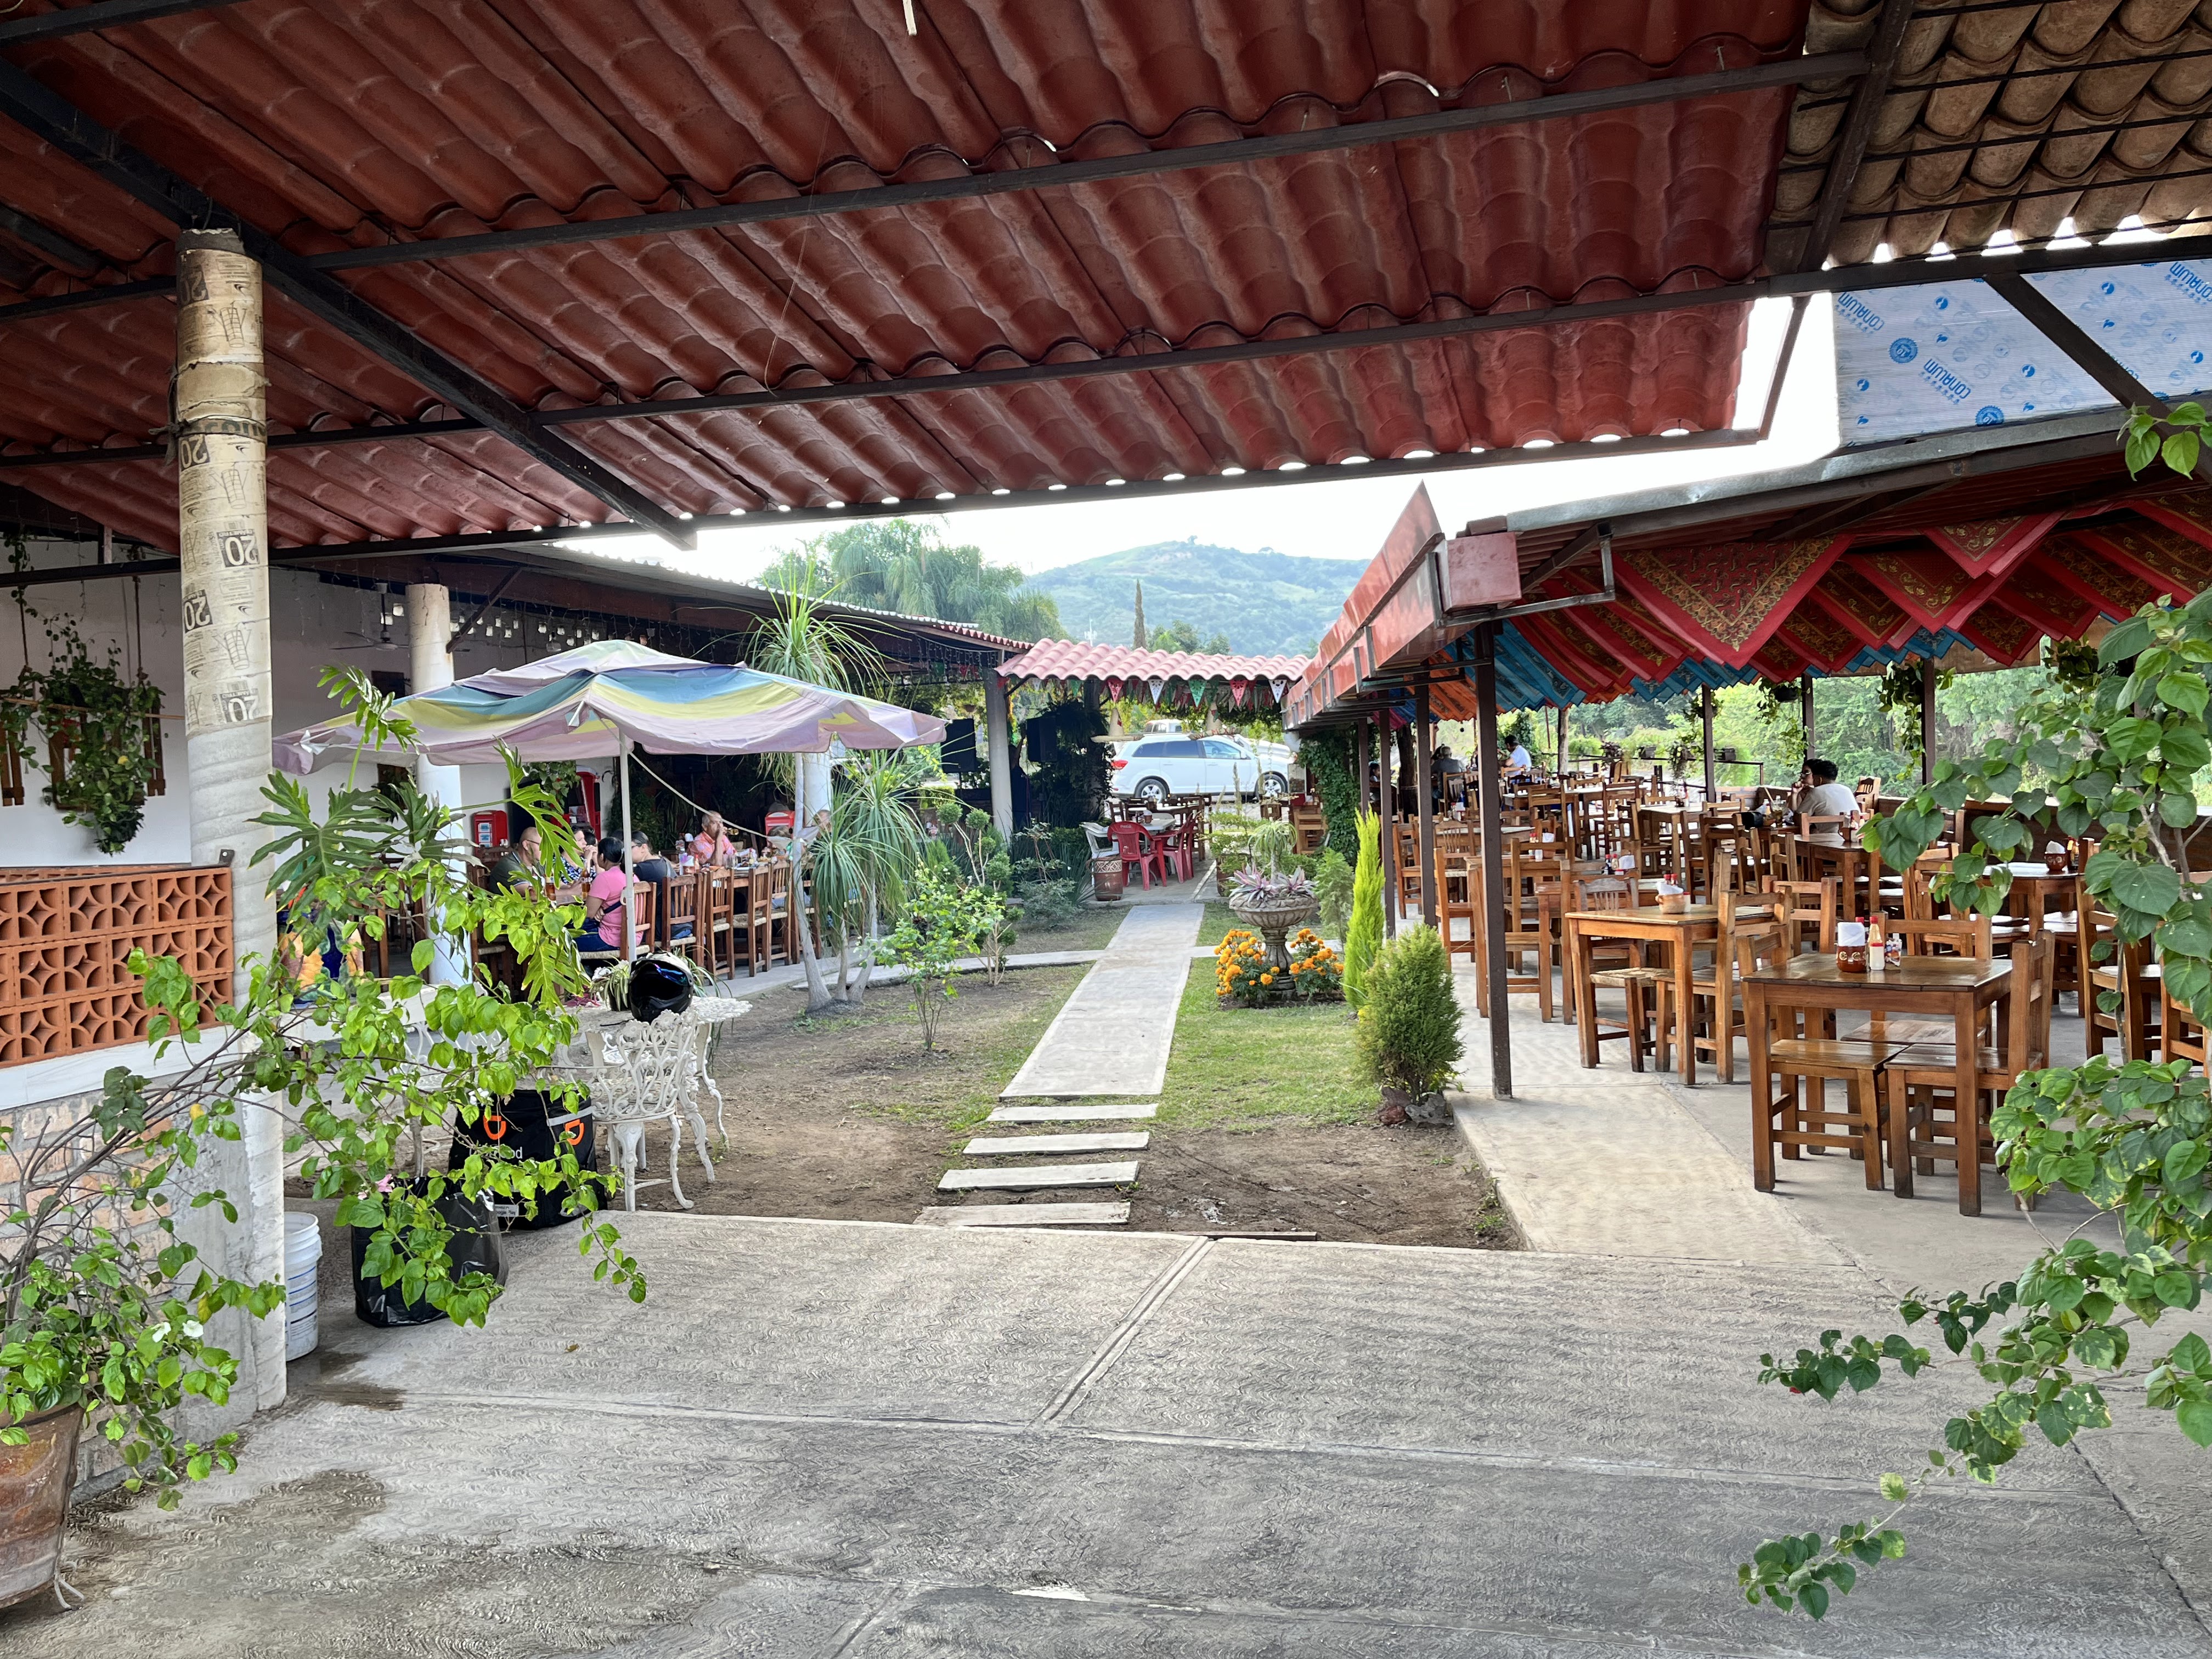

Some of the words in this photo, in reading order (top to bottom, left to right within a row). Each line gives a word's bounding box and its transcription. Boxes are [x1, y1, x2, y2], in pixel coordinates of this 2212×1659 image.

[2169, 261, 2212, 302] ONALUM
[1838, 291, 1884, 330] CONALUM
[1924, 358, 1971, 399] CONALUM
[181, 435, 207, 468] 20
[224, 535, 258, 566] 20
[184, 596, 210, 630] 20
[228, 695, 259, 722] 20
